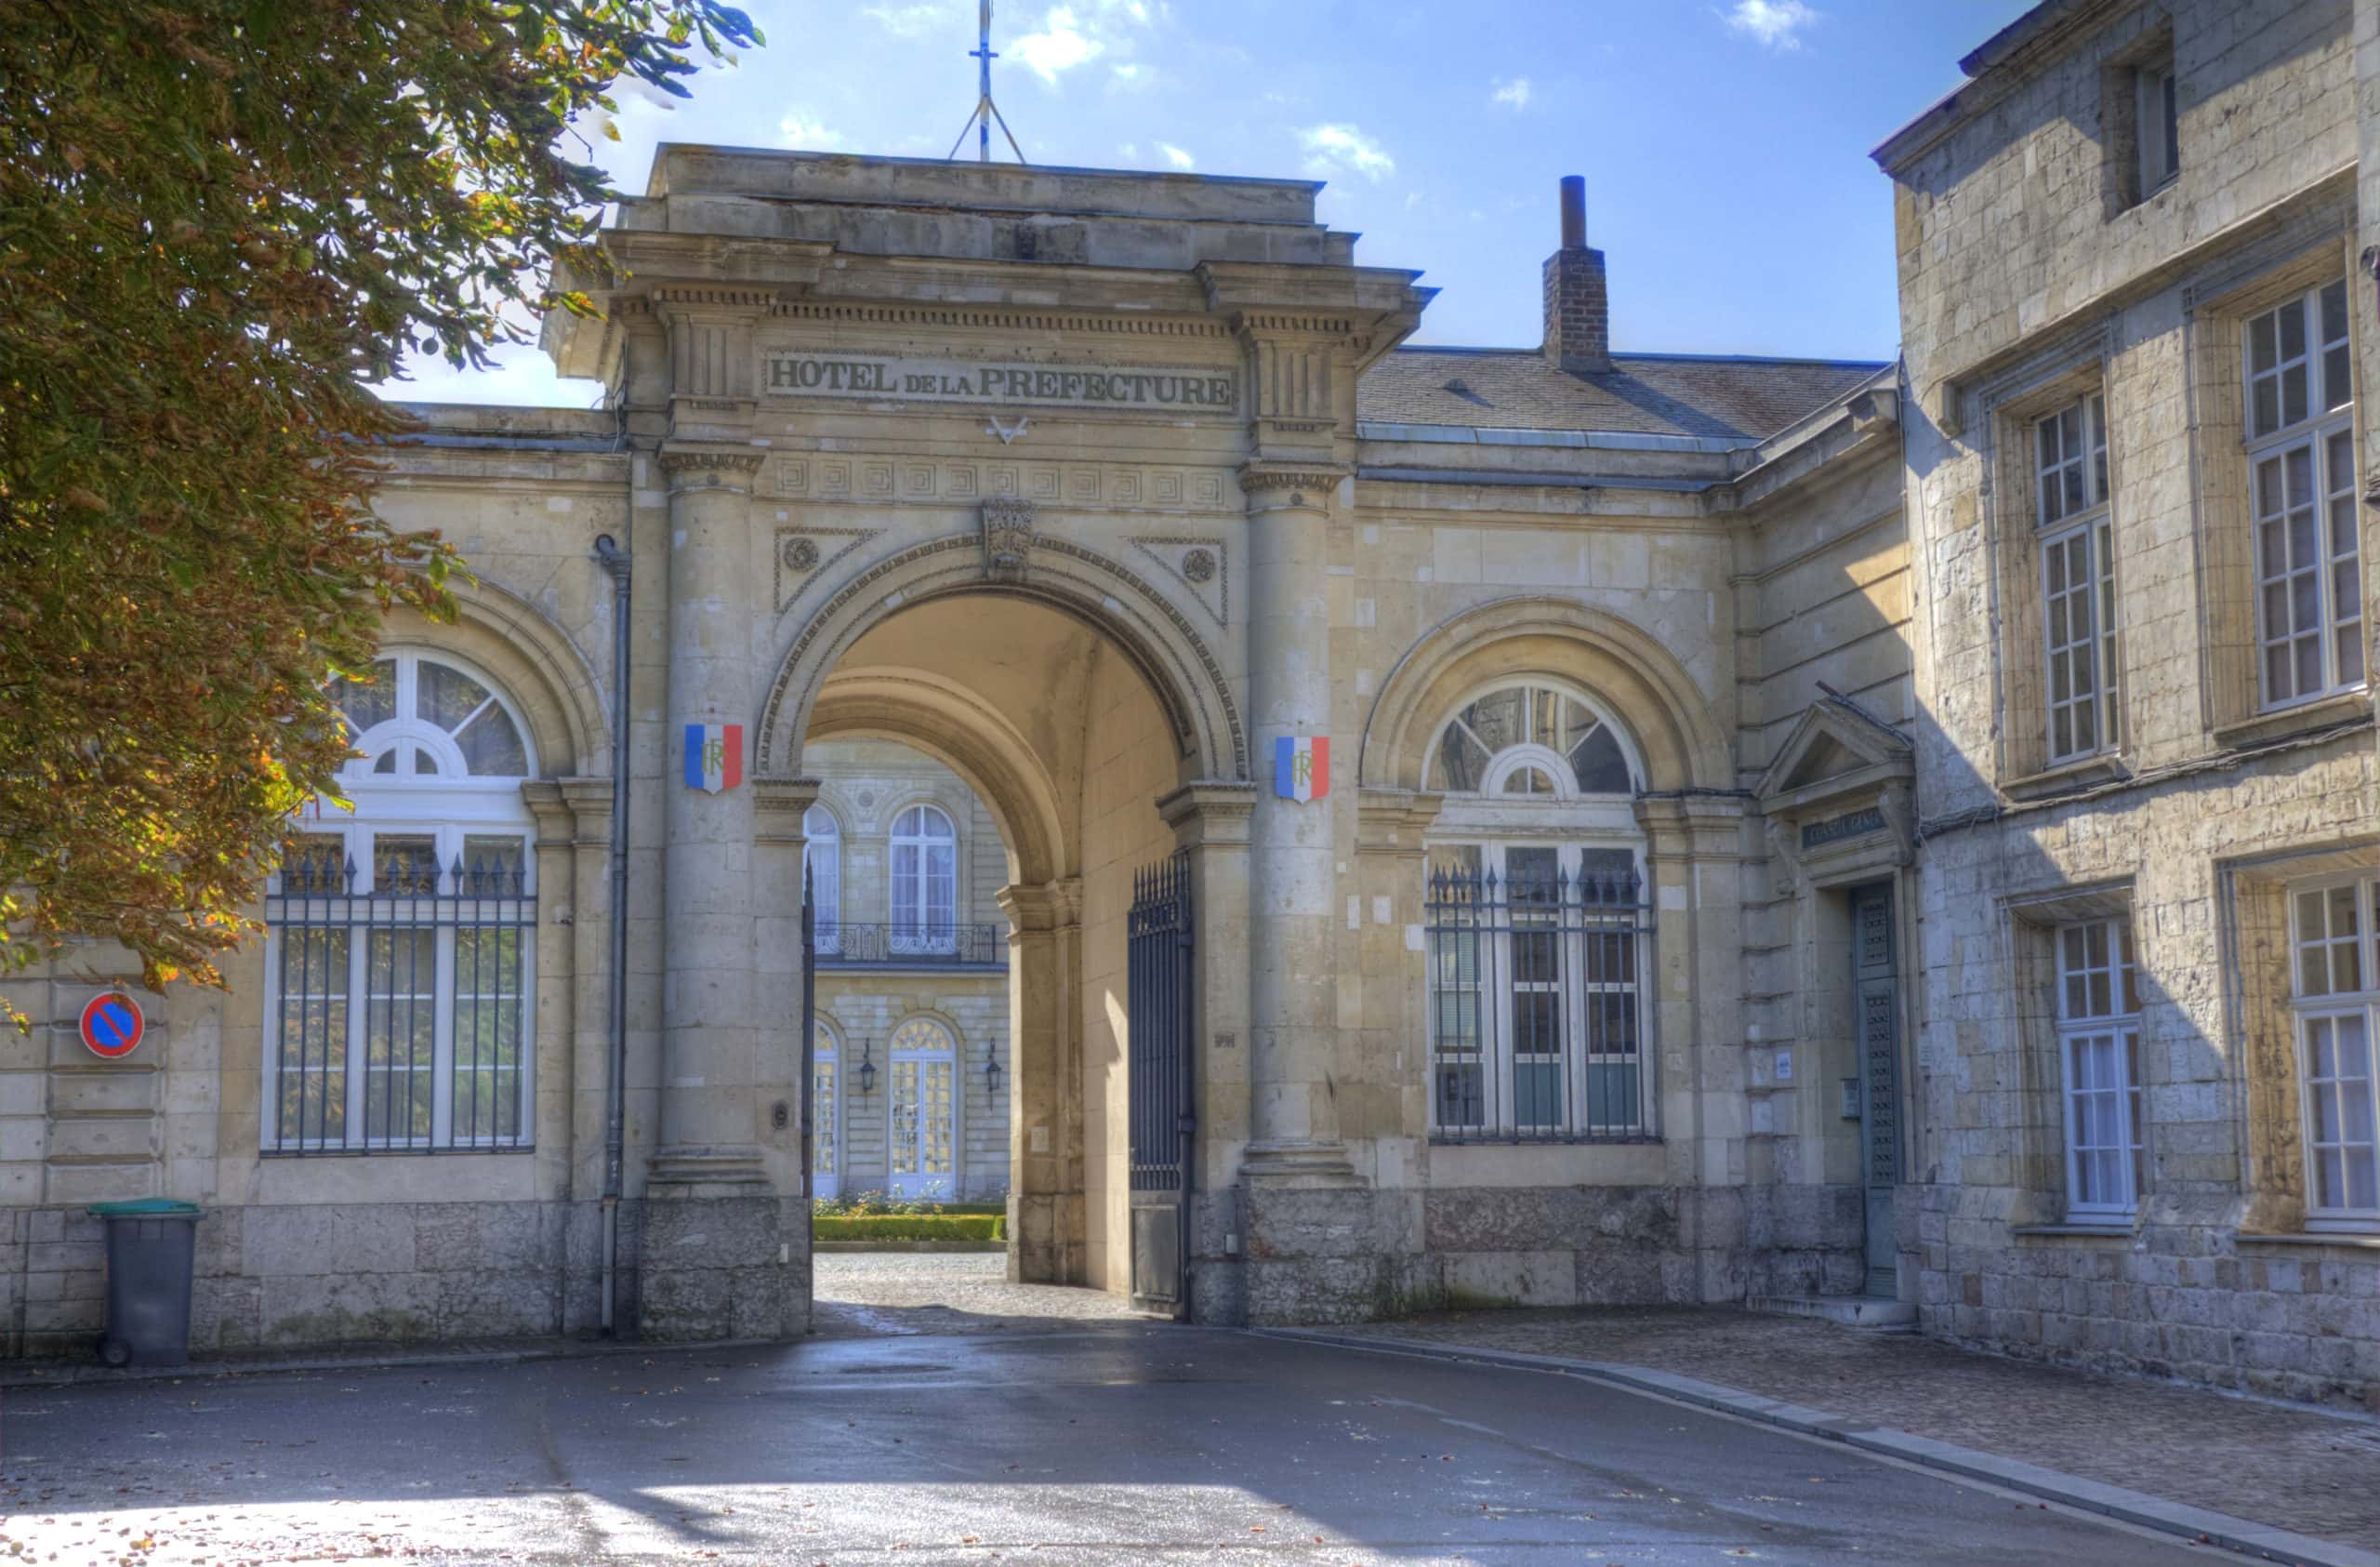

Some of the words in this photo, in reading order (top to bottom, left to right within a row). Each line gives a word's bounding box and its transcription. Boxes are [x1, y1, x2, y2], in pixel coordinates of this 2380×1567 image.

[771, 359, 898, 392] HOTEL
[905, 374, 936, 393] DE
[941, 375, 974, 395] LA
[979, 368, 1231, 405] PREFECTURE
